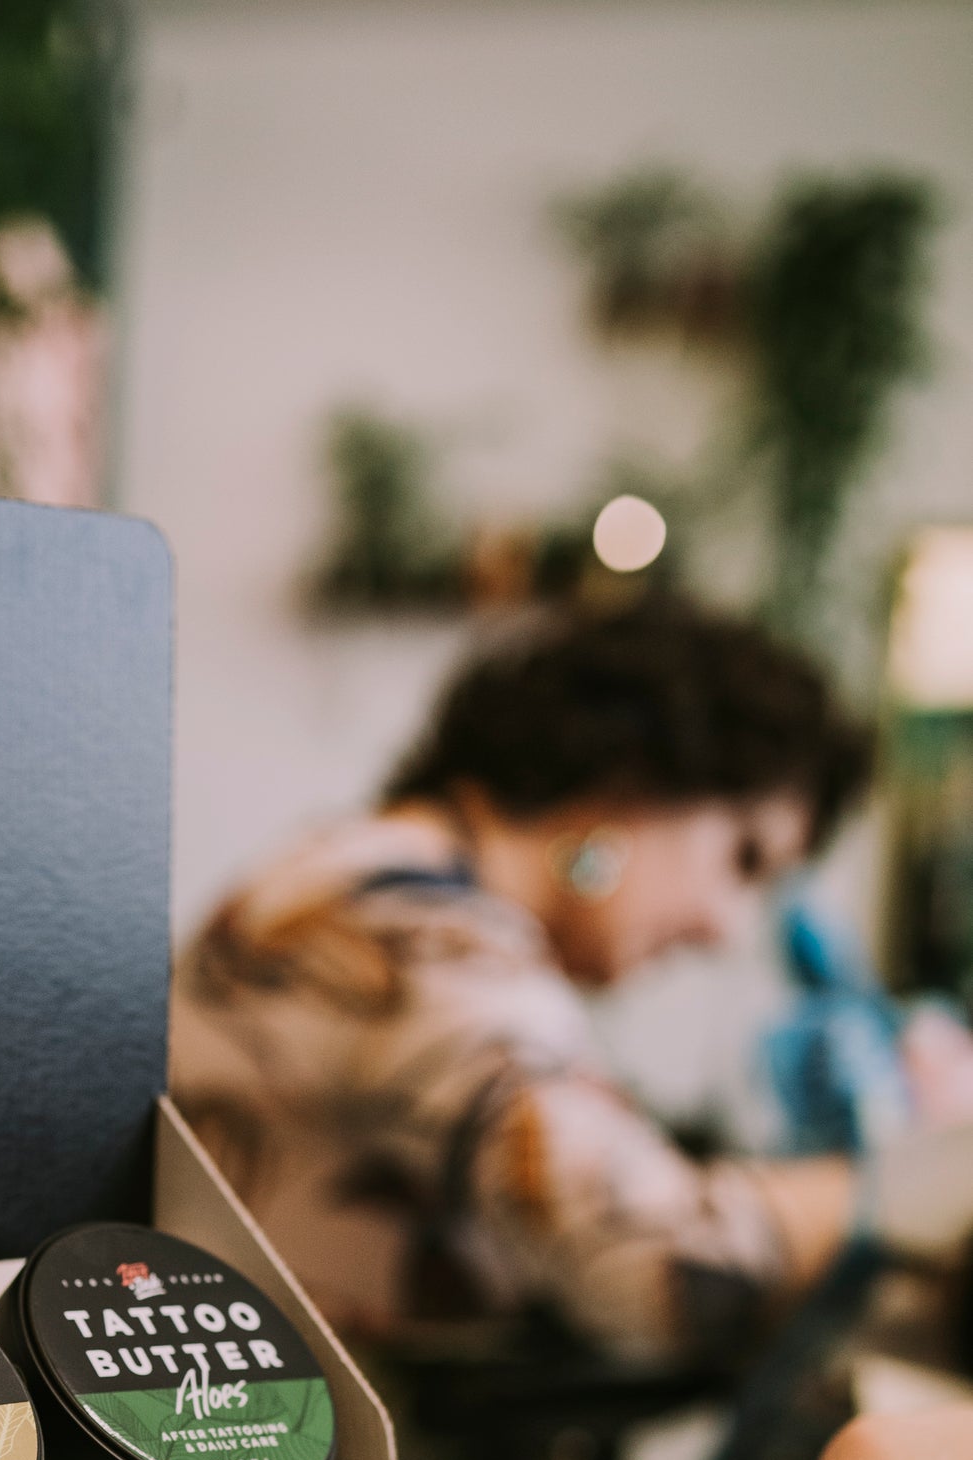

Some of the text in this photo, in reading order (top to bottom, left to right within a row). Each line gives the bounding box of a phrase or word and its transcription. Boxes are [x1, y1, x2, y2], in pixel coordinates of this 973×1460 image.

[63, 1301, 262, 1339] TATTOO
[85, 1338, 285, 1379] BUTTER
[175, 1358, 249, 1420] Aloes
[161, 1421, 289, 1443] AFTER TATTOOING
[195, 1438, 239, 1453] DAILY
[240, 1434, 280, 1450] CARE
